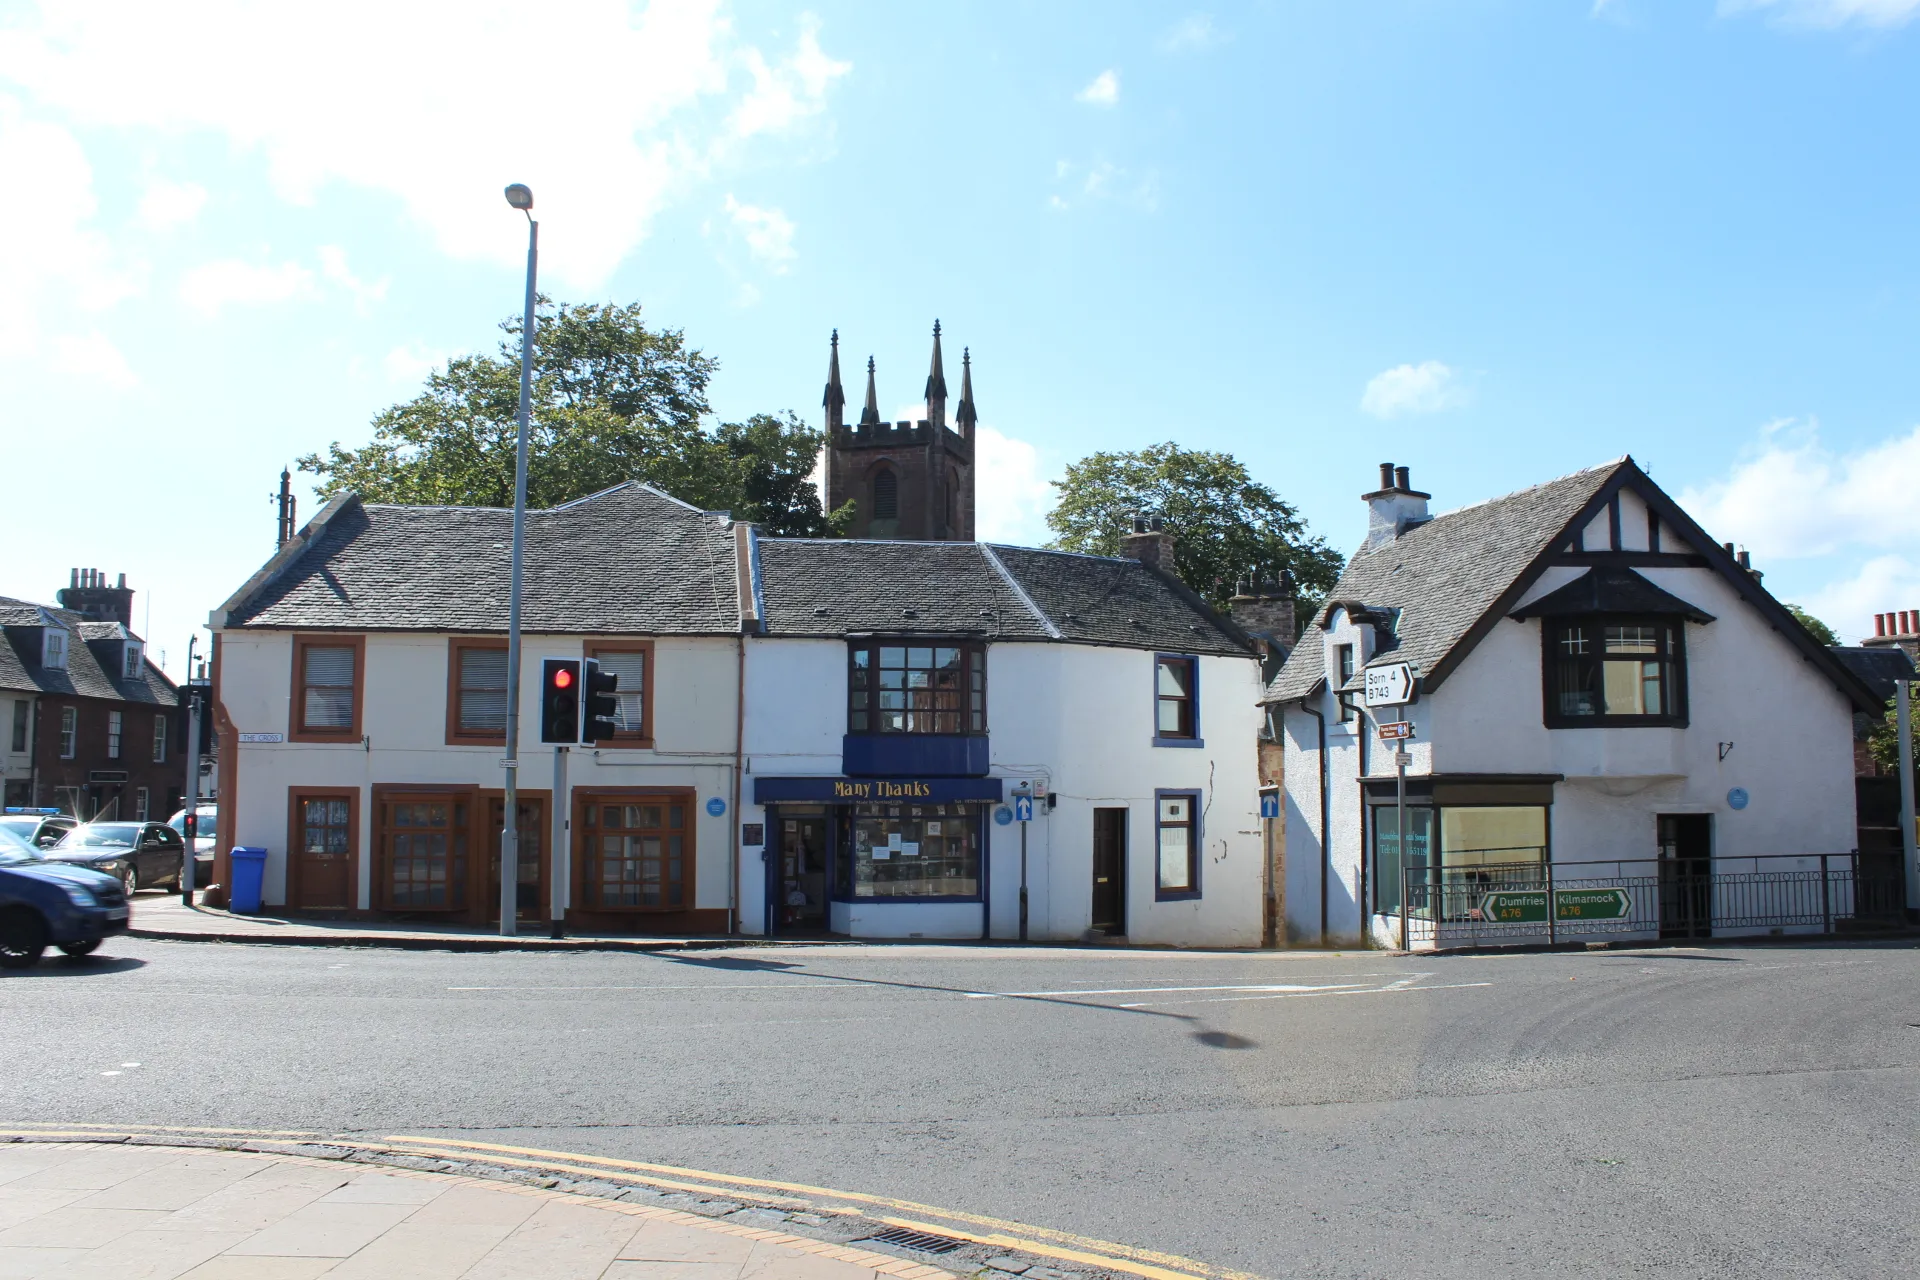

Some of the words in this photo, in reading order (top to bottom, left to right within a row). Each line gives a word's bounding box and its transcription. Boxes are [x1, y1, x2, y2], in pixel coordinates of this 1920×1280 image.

[1368, 673, 1386, 685] Sorn
[1390, 670, 1396, 681] 4
[1369, 686, 1389, 699] B743
[834, 781, 871, 798] Many
[876, 781, 930, 797] Thanks
[1500, 897, 1544, 907] Dumfries
[1560, 894, 1614, 904] Kilmarnock
[1502, 908, 1522, 918] A76
[1560, 906, 1580, 916] A76
